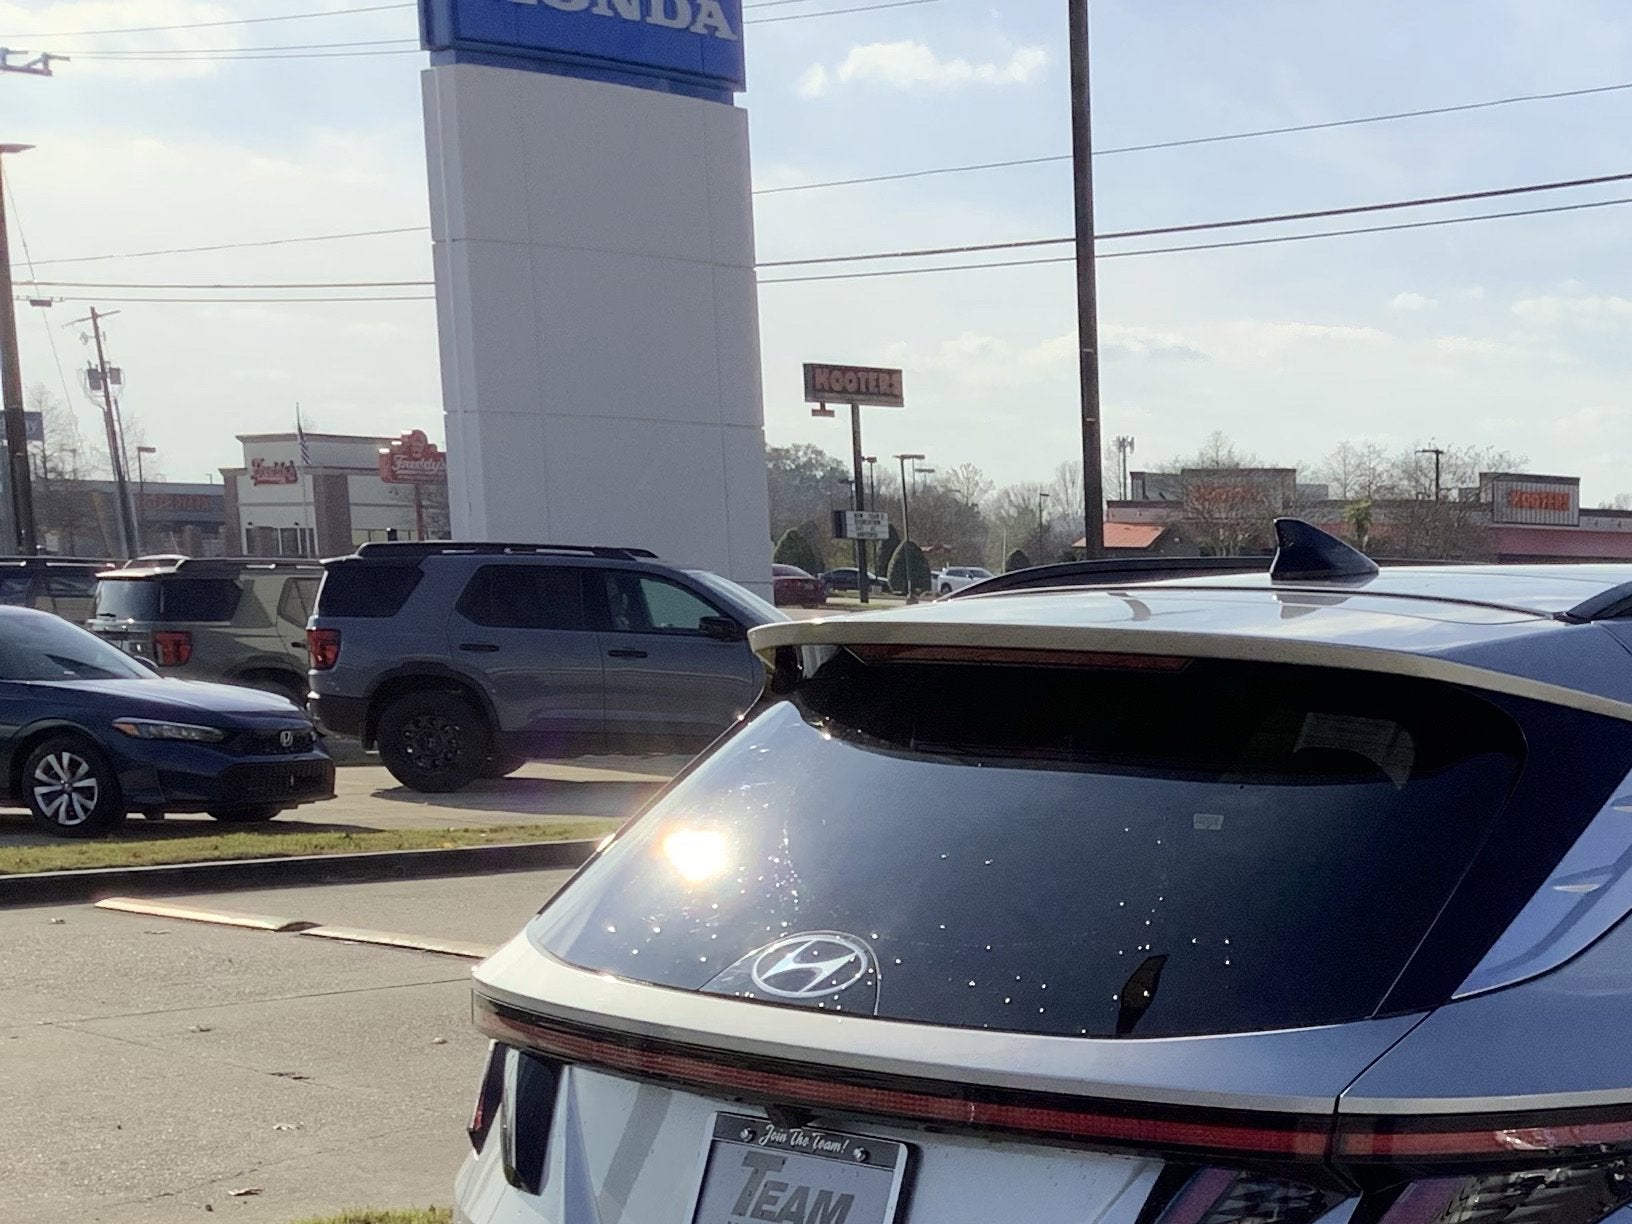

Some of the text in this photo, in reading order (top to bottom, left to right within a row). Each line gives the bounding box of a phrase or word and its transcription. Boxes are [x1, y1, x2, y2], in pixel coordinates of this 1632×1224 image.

[758, 1123, 850, 1154] Join The Team!
